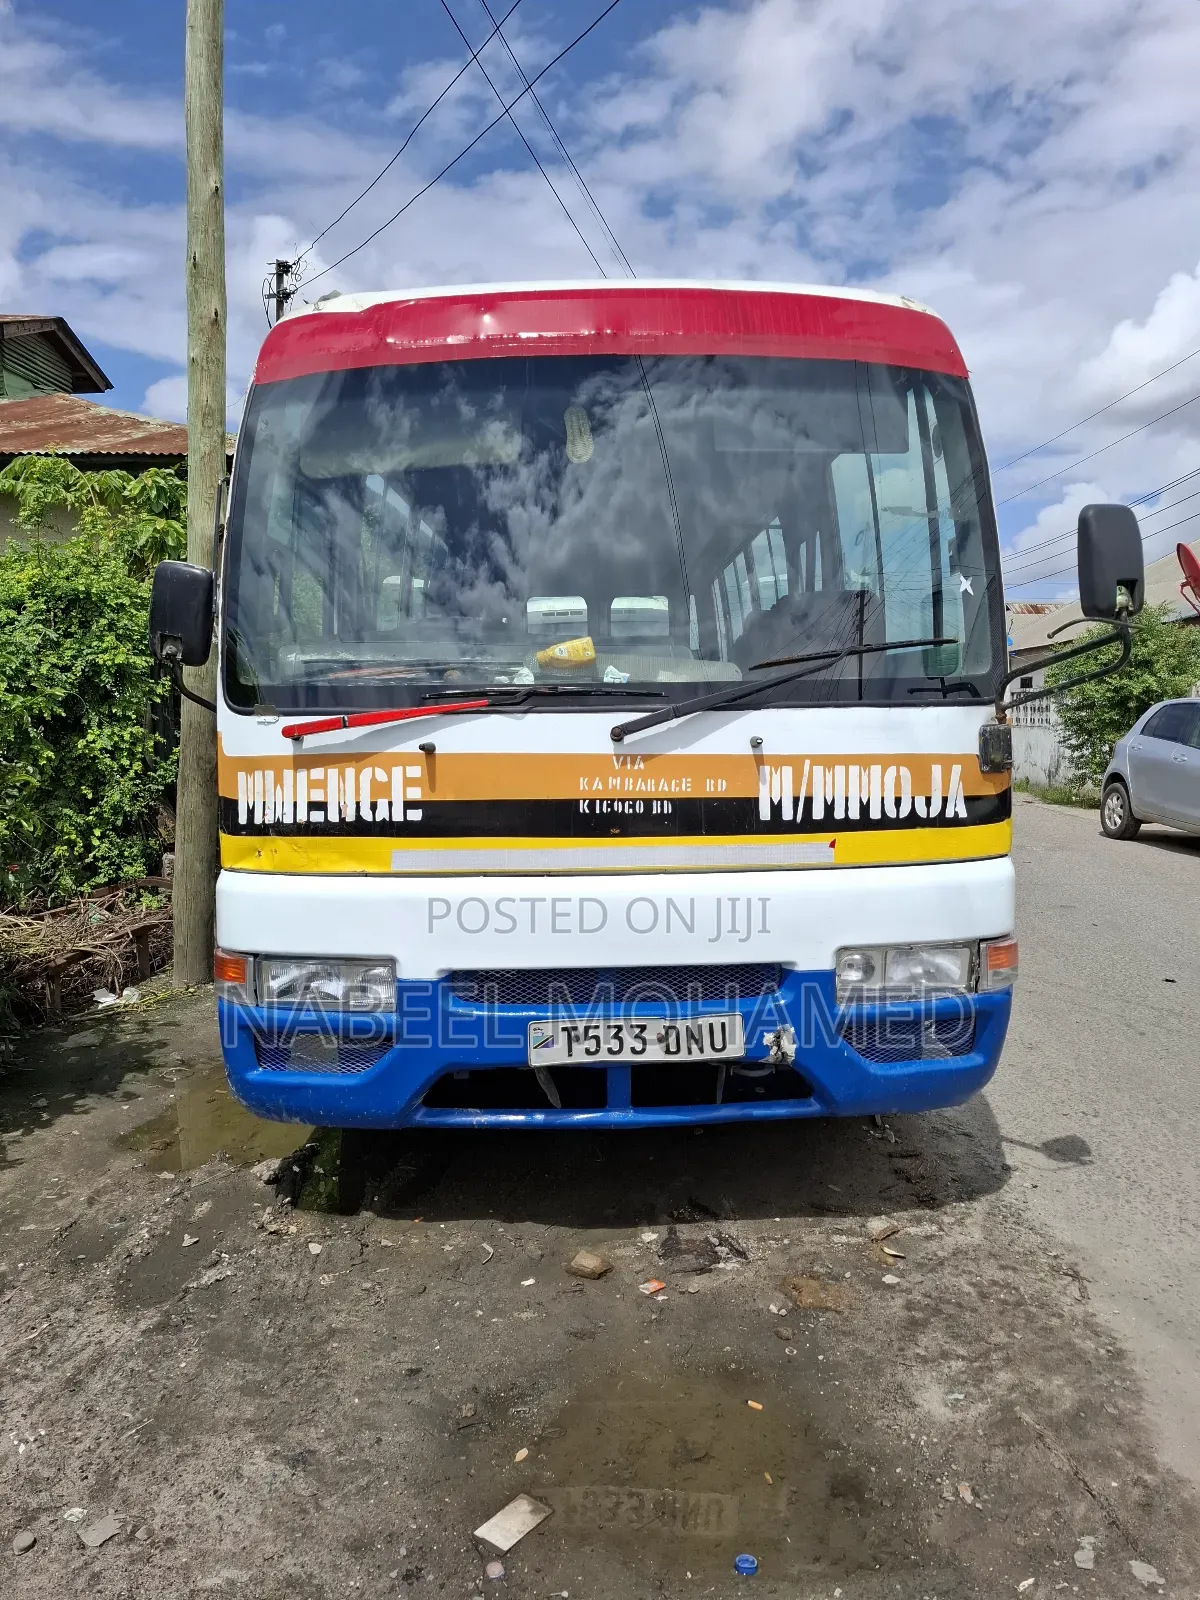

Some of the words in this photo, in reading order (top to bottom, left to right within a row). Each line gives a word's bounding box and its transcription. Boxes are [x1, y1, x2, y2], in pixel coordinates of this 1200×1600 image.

[612, 755, 645, 770] VIA
[237, 765, 423, 825] MWENGE
[579, 776, 692, 793] KAMBARAGE
[705, 778, 727, 792] RD
[758, 759, 968, 824] M/MMOJA
[652, 799, 673, 814] RD
[561, 1022, 648, 1058] T533
[663, 1021, 728, 1055] DNU
